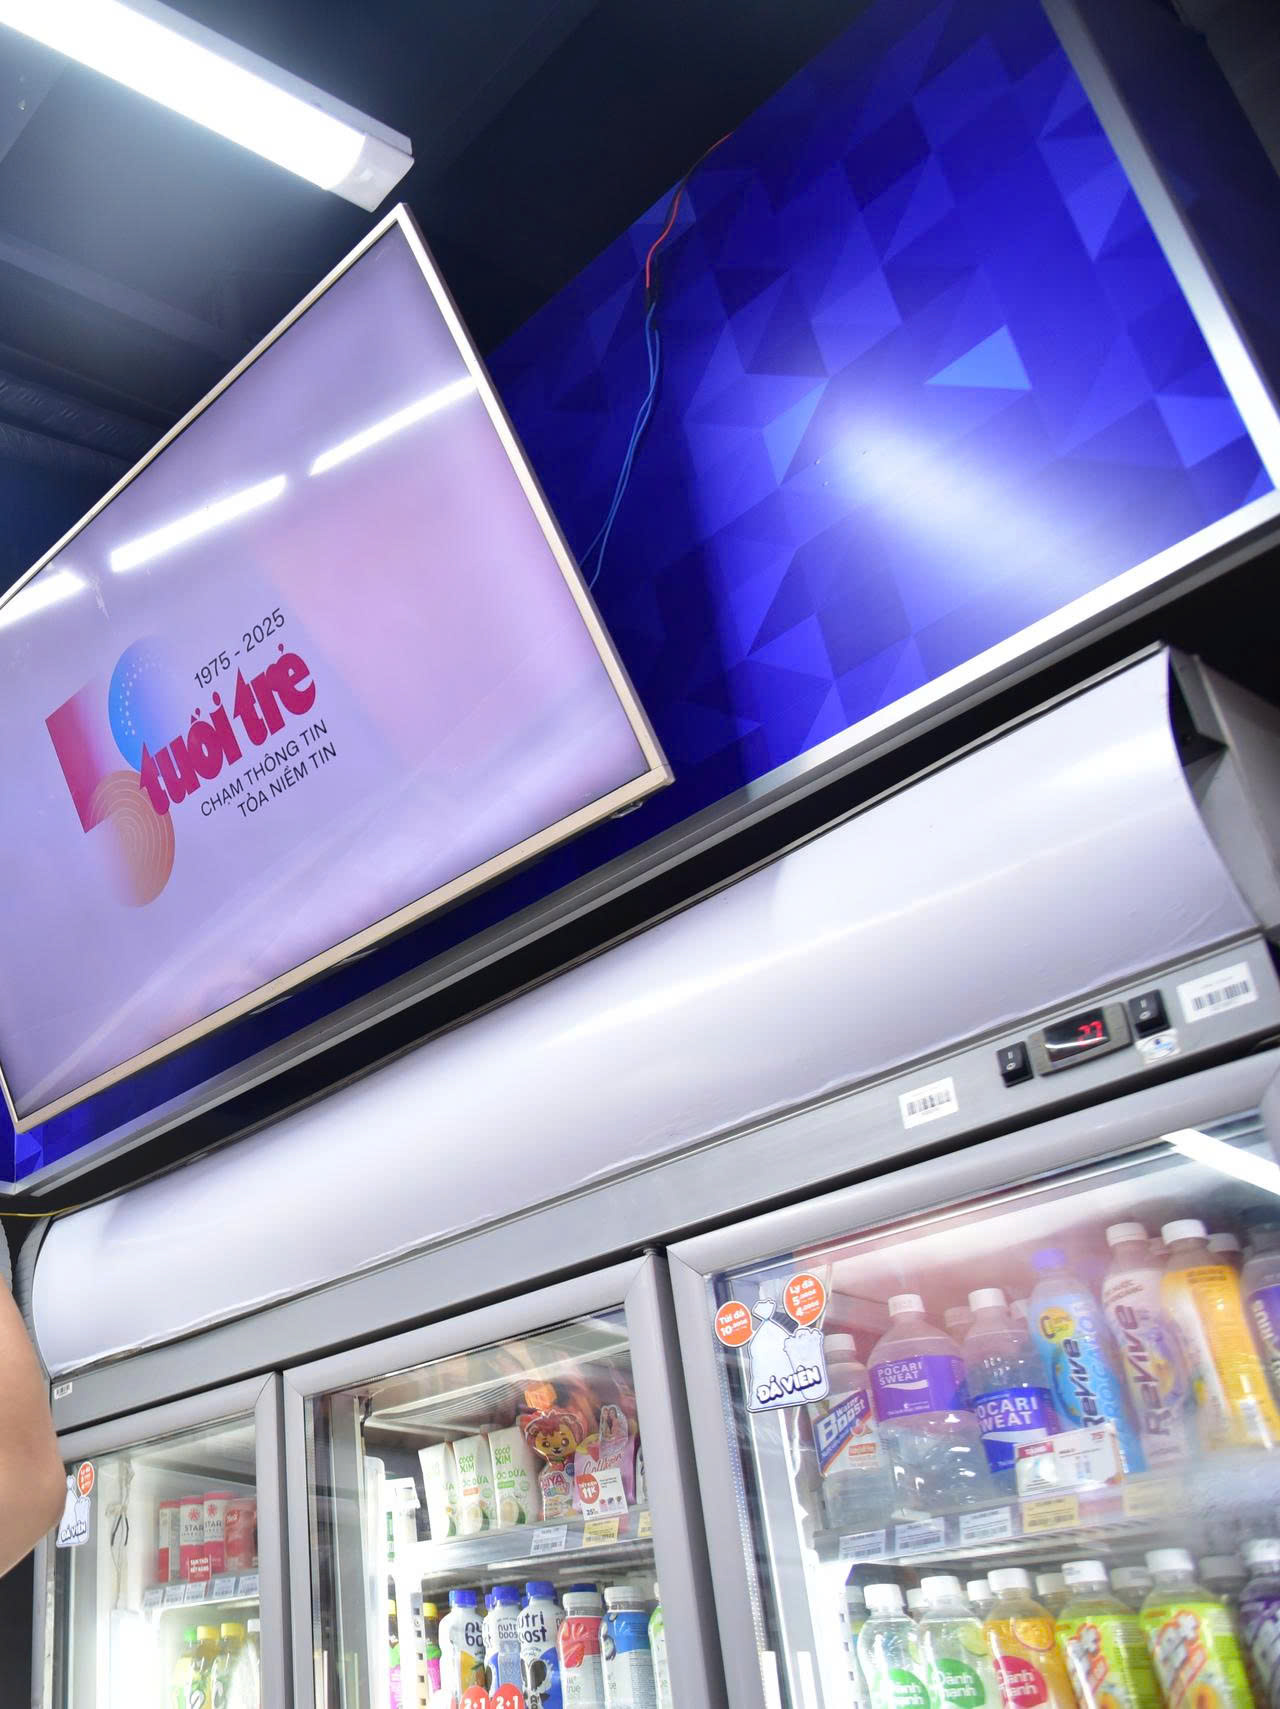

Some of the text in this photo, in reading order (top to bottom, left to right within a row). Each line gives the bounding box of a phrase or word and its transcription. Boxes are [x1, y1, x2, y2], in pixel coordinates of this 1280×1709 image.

[194, 652, 231, 688] 1975
[242, 607, 286, 652] 2025
[233, 643, 316, 746] trẻ
[200, 719, 329, 818] CHẠM THÔNG TIN
[237, 742, 337, 818] TỎA NIỀM TIN
[789, 1284, 802, 1295] Ly
[756, 1364, 822, 1404] ĐÁ VIÊN
[877, 1361, 924, 1377] POCARI
[878, 1371, 920, 1387] SWEAT
[977, 1395, 1039, 1421] OCARI
[979, 1410, 1033, 1433] WEAT
[818, 1398, 868, 1452] BOOST
[498, 1631, 518, 1639] boos
